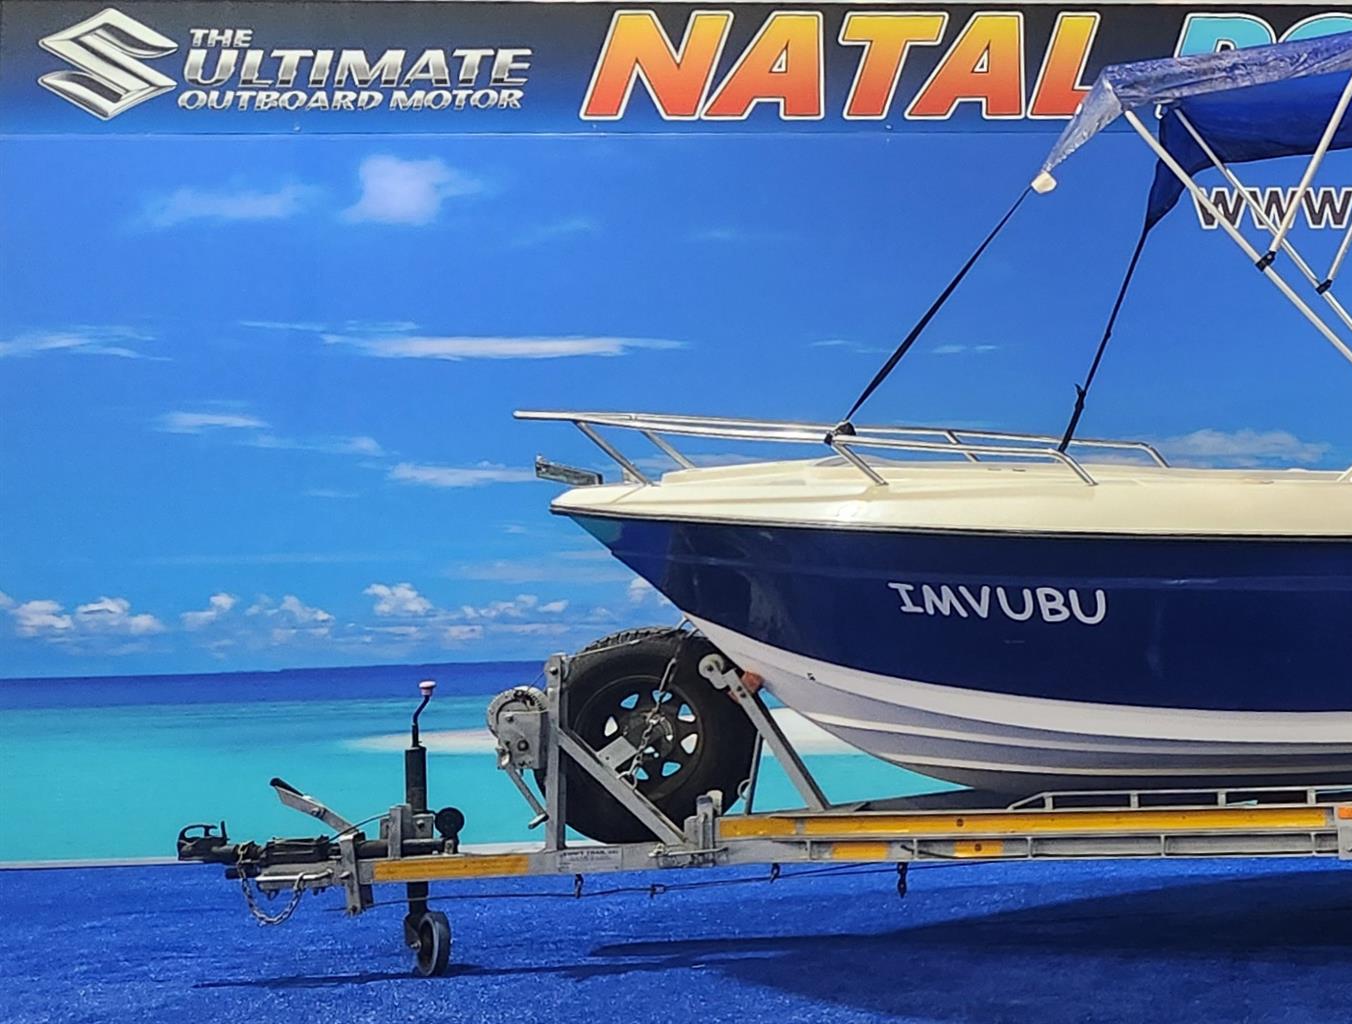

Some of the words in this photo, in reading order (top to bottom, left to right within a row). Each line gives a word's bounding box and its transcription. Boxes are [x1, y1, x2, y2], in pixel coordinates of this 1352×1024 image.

[190, 28, 253, 48] THE
[184, 48, 533, 88] ULTIMATE
[579, 10, 1102, 120] NATAL
[178, 89, 382, 112] OUTBOARD
[388, 89, 525, 111] MOTOR
[888, 582, 1107, 625] IMVUBU
